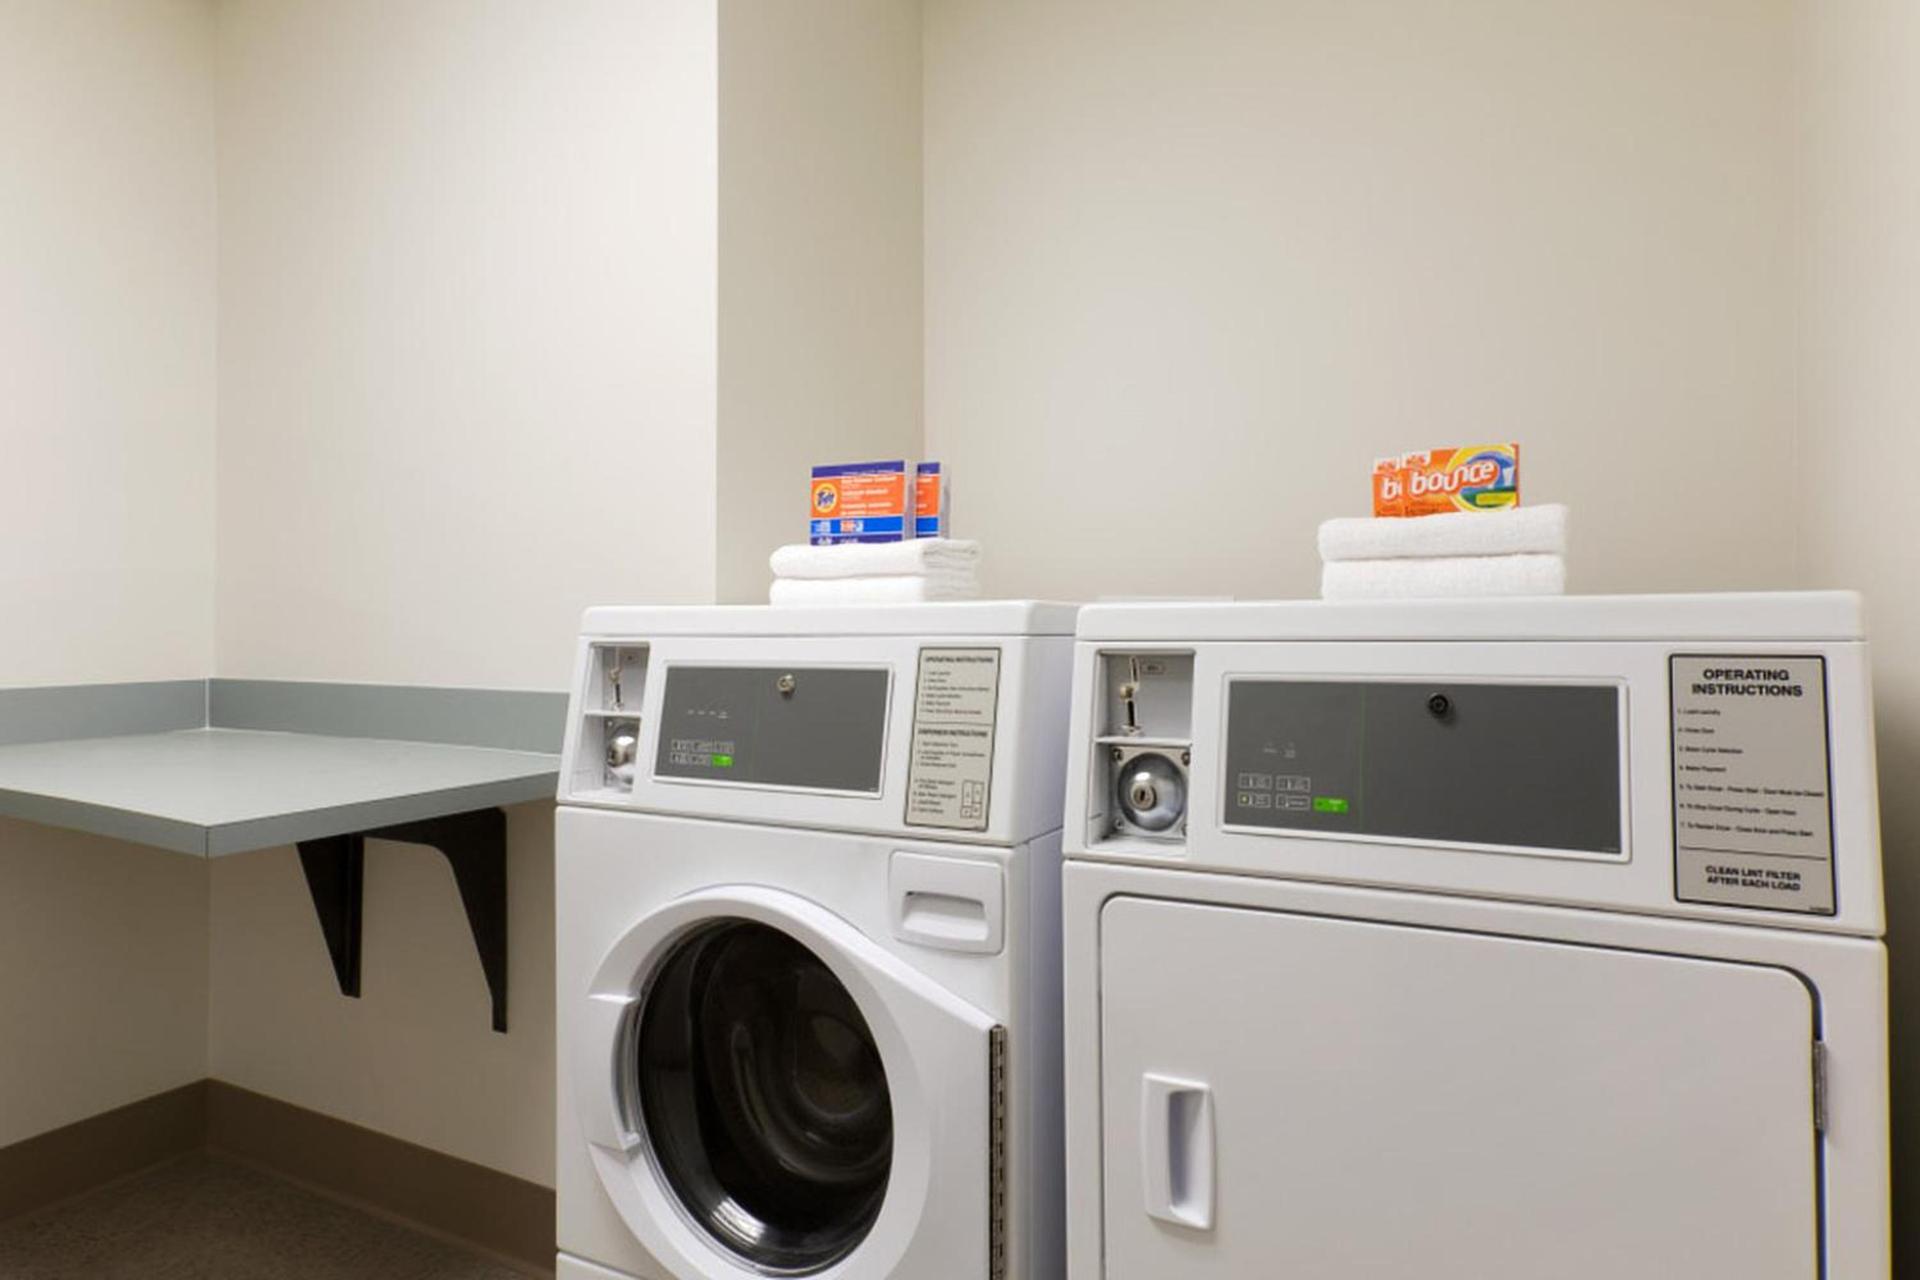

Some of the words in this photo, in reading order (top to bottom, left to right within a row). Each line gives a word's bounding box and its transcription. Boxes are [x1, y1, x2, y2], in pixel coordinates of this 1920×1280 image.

[1412, 460, 1495, 495] bounce
[1703, 669, 1790, 681] OPERATING
[1692, 683, 1804, 697] INSTRUCTIONS
[1706, 865, 1739, 876] CLEAN
[1741, 868, 1763, 878] LINT
[1766, 870, 1801, 881] FILTER
[1707, 876, 1739, 886] AFTER
[1741, 878, 1770, 888] EACH
[1771, 881, 1801, 891] LOAD
